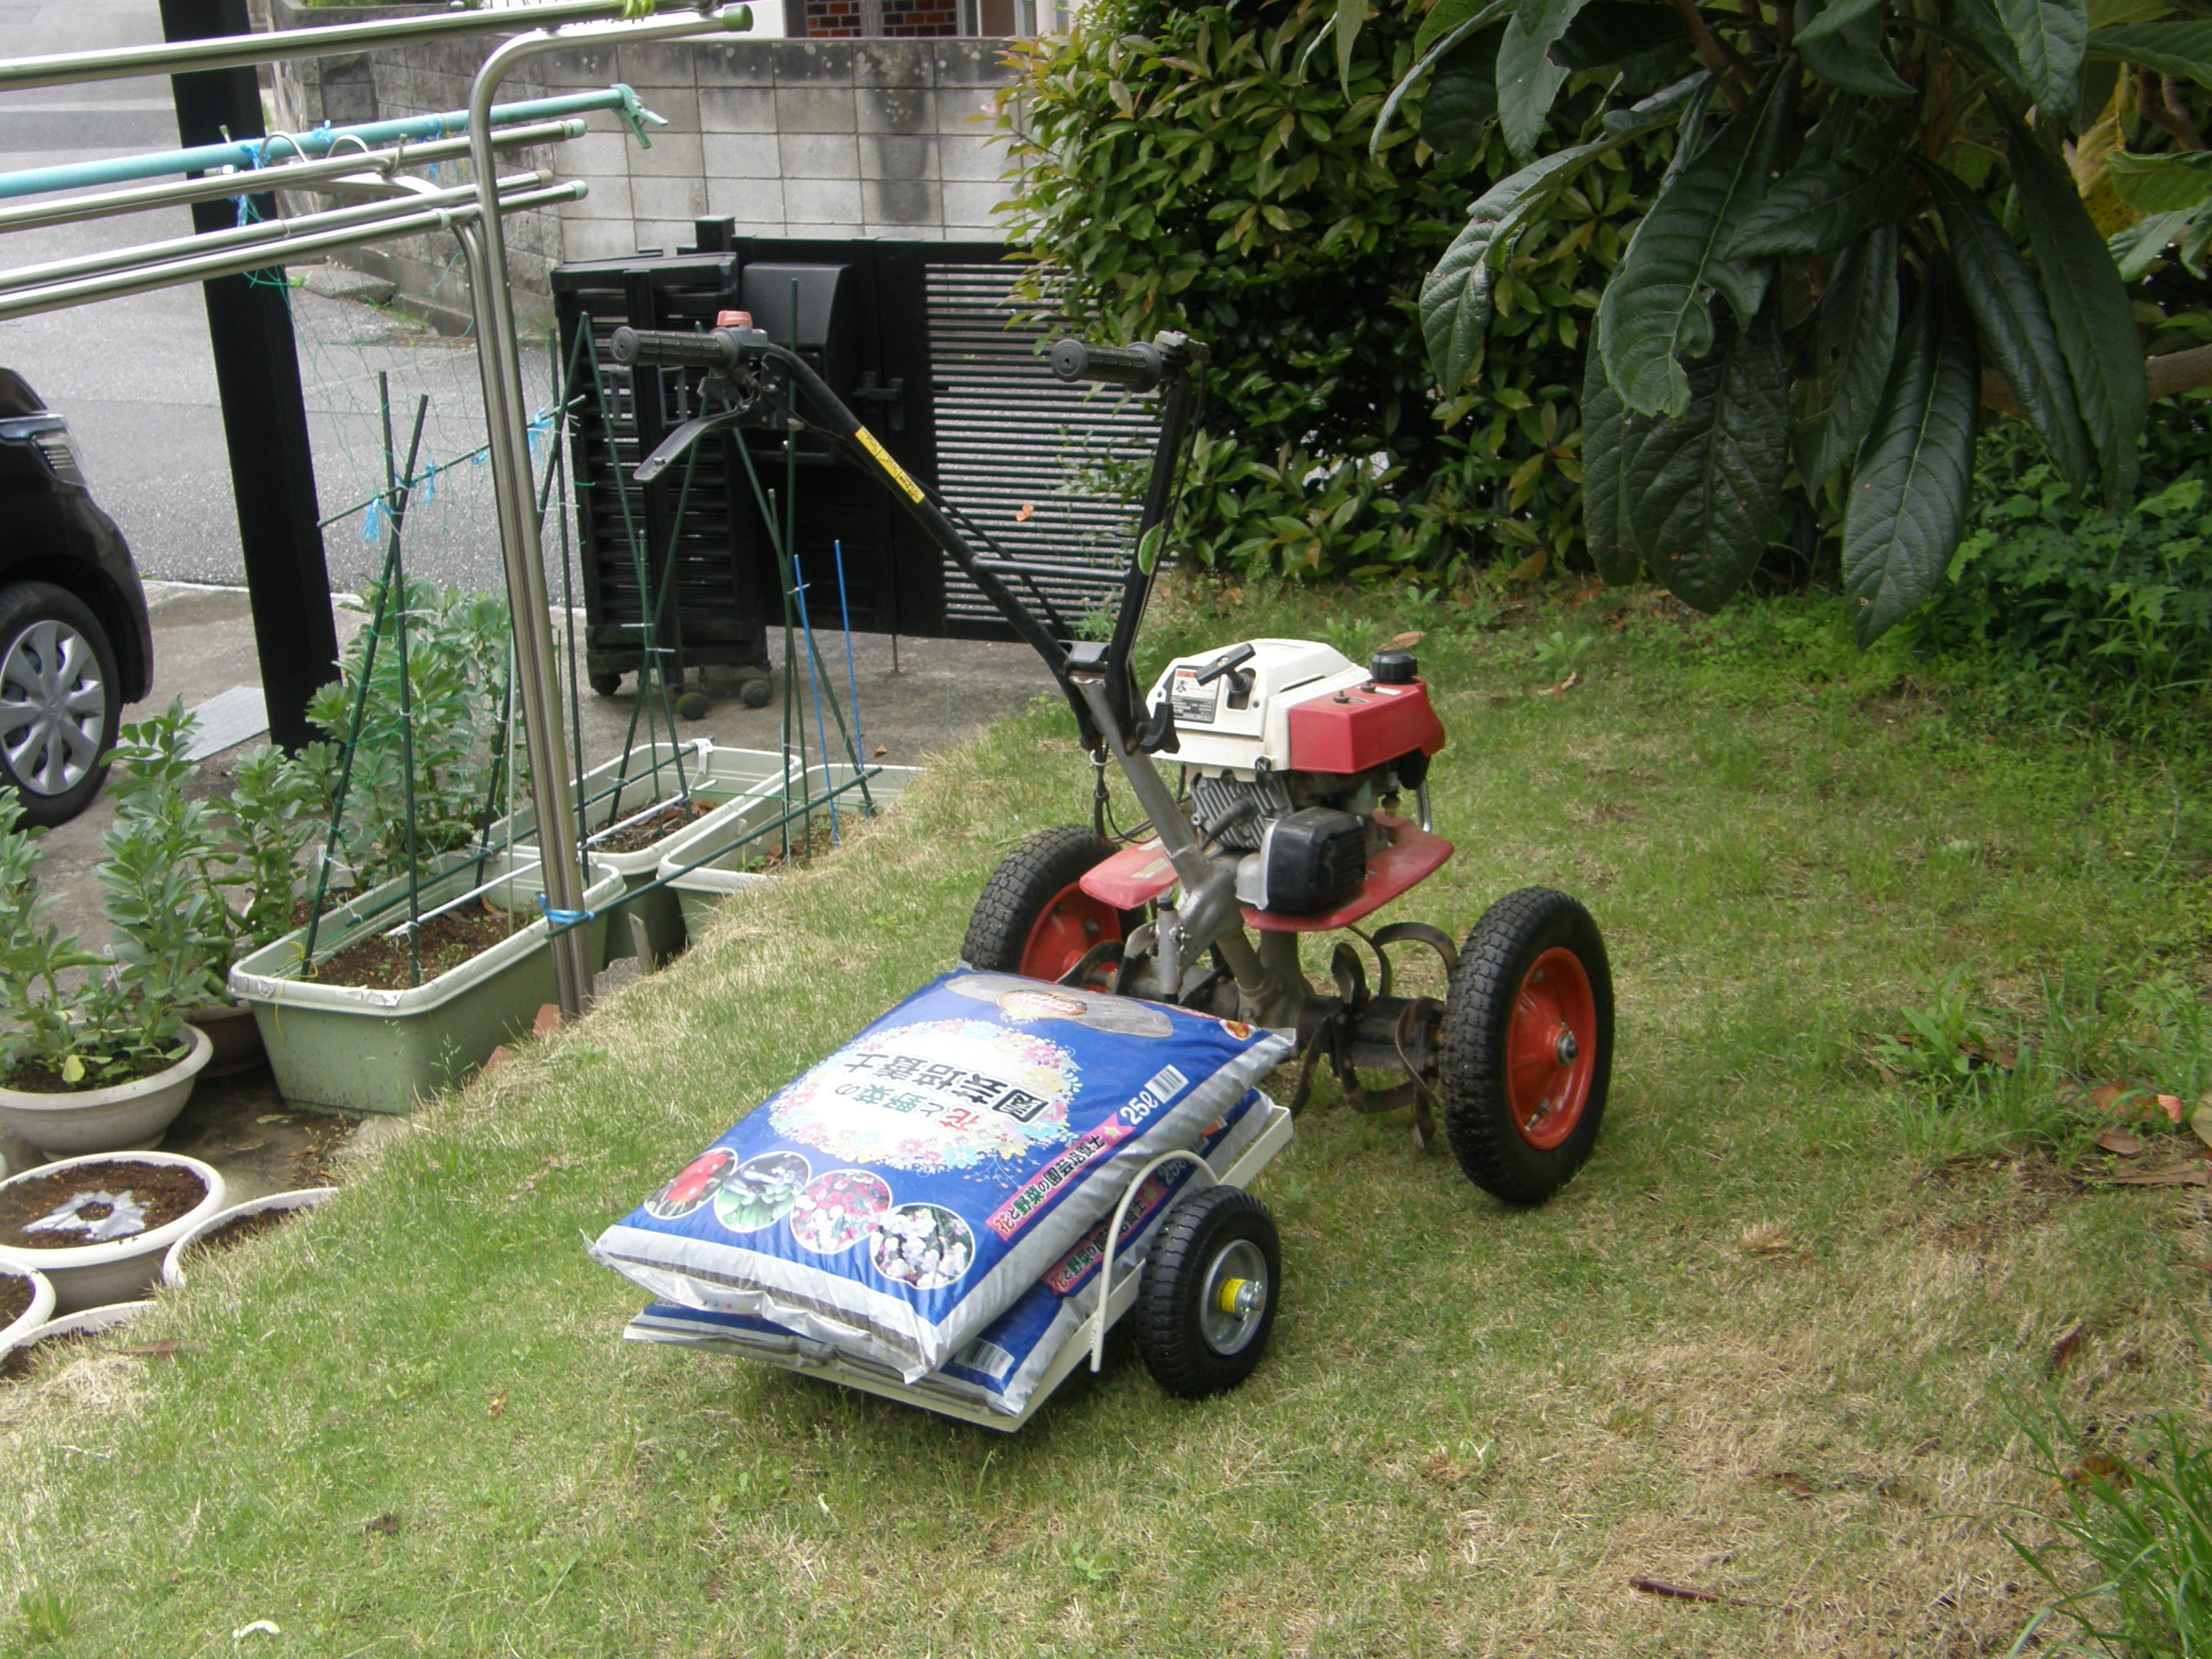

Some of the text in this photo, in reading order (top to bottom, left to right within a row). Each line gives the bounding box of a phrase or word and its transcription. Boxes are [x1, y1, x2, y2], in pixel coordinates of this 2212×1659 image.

[834, 1084, 981, 1130] 花と野菜の
[844, 1053, 1049, 1123] 園芸培養土
[994, 1135, 1105, 1234] 花と野菜の園芸培養土
